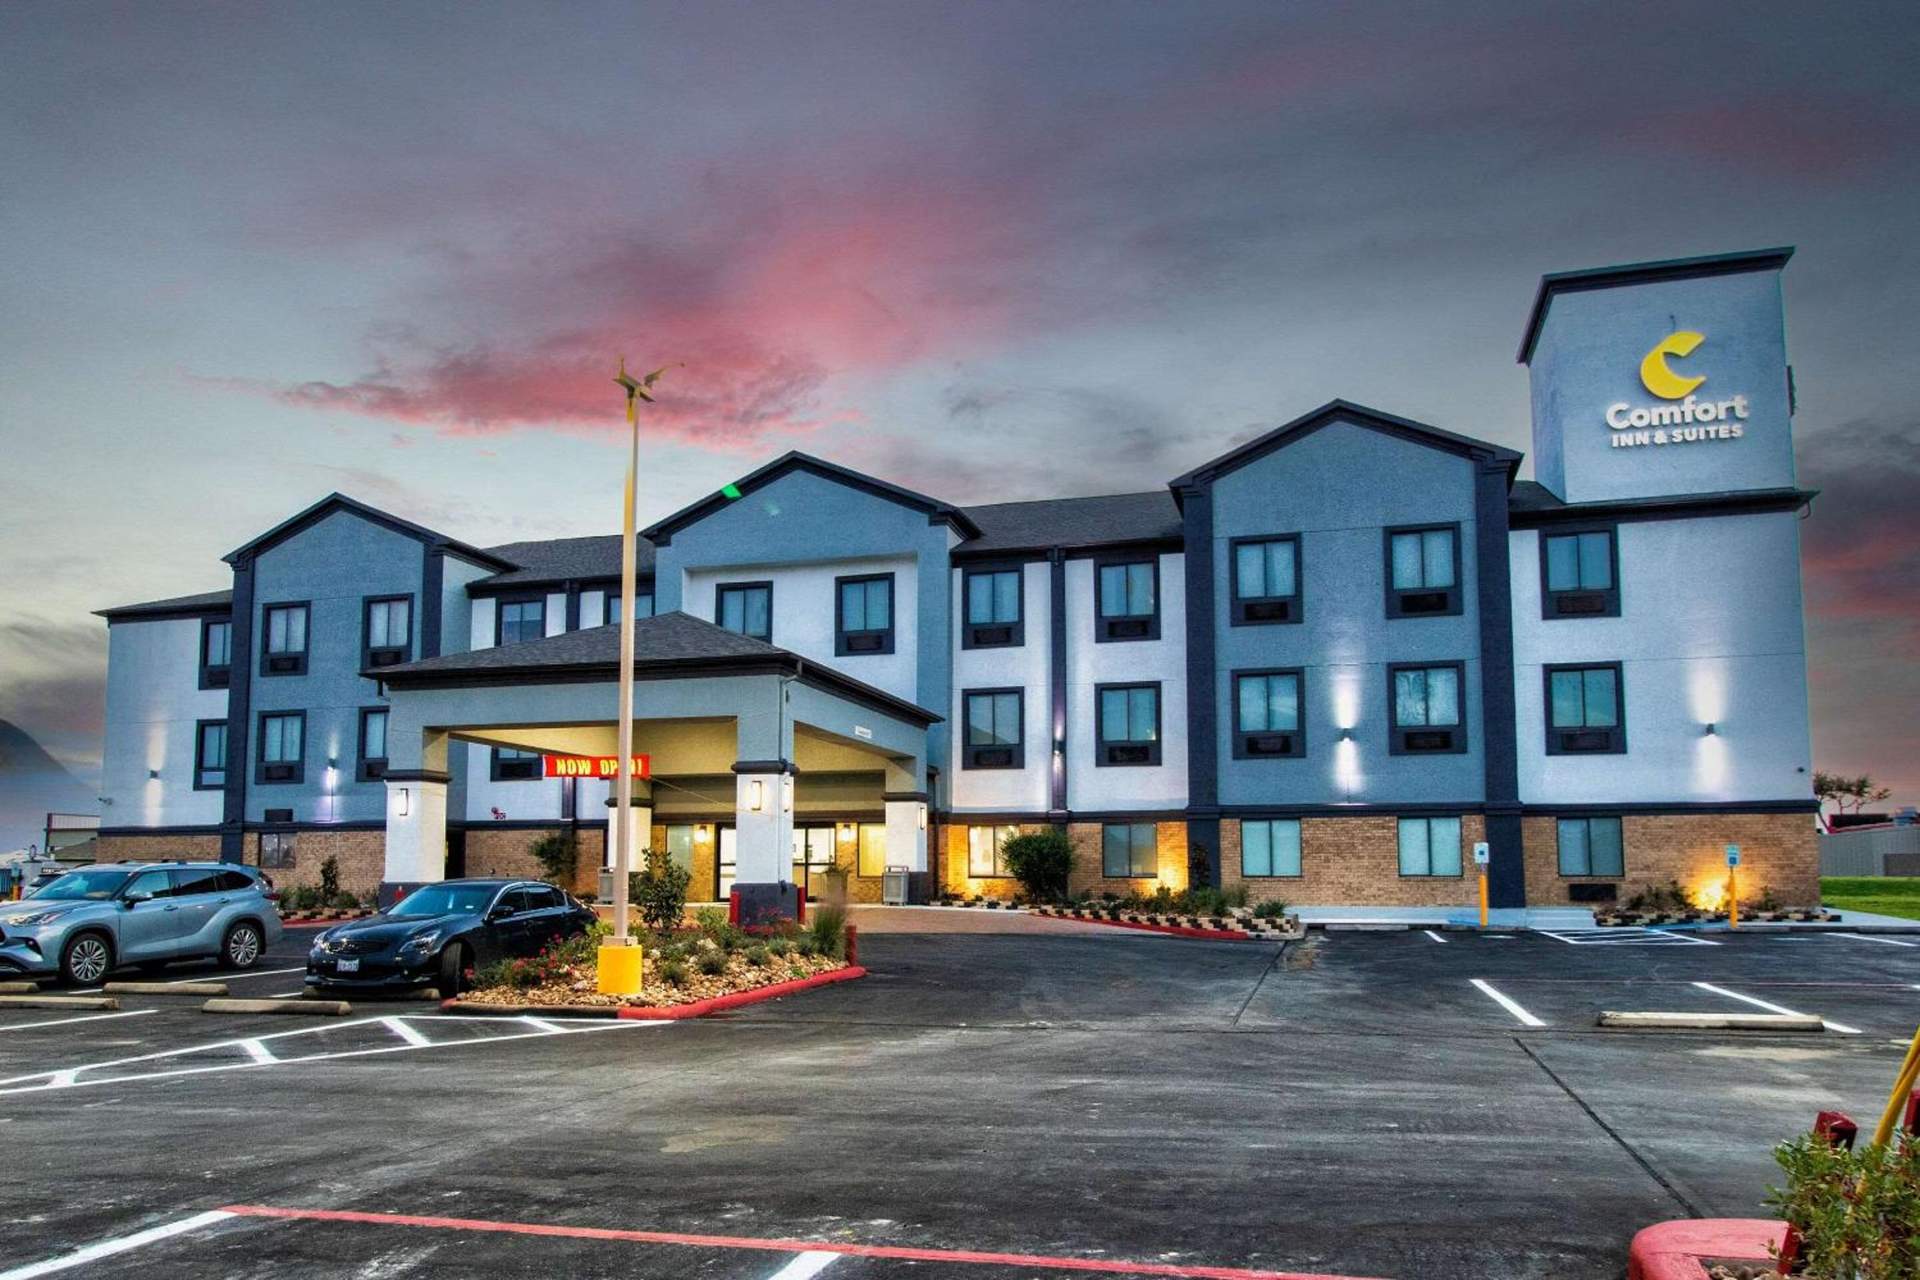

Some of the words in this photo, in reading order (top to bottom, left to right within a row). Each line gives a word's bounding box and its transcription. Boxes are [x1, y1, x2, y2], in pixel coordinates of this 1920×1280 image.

[1606, 395, 1748, 429] Comfort
[1612, 432, 1649, 447] INN
[1653, 430, 1667, 444] &
[1672, 424, 1743, 443] SUITES
[556, 758, 592, 775] NOW
[600, 758, 642, 775] OPN!
